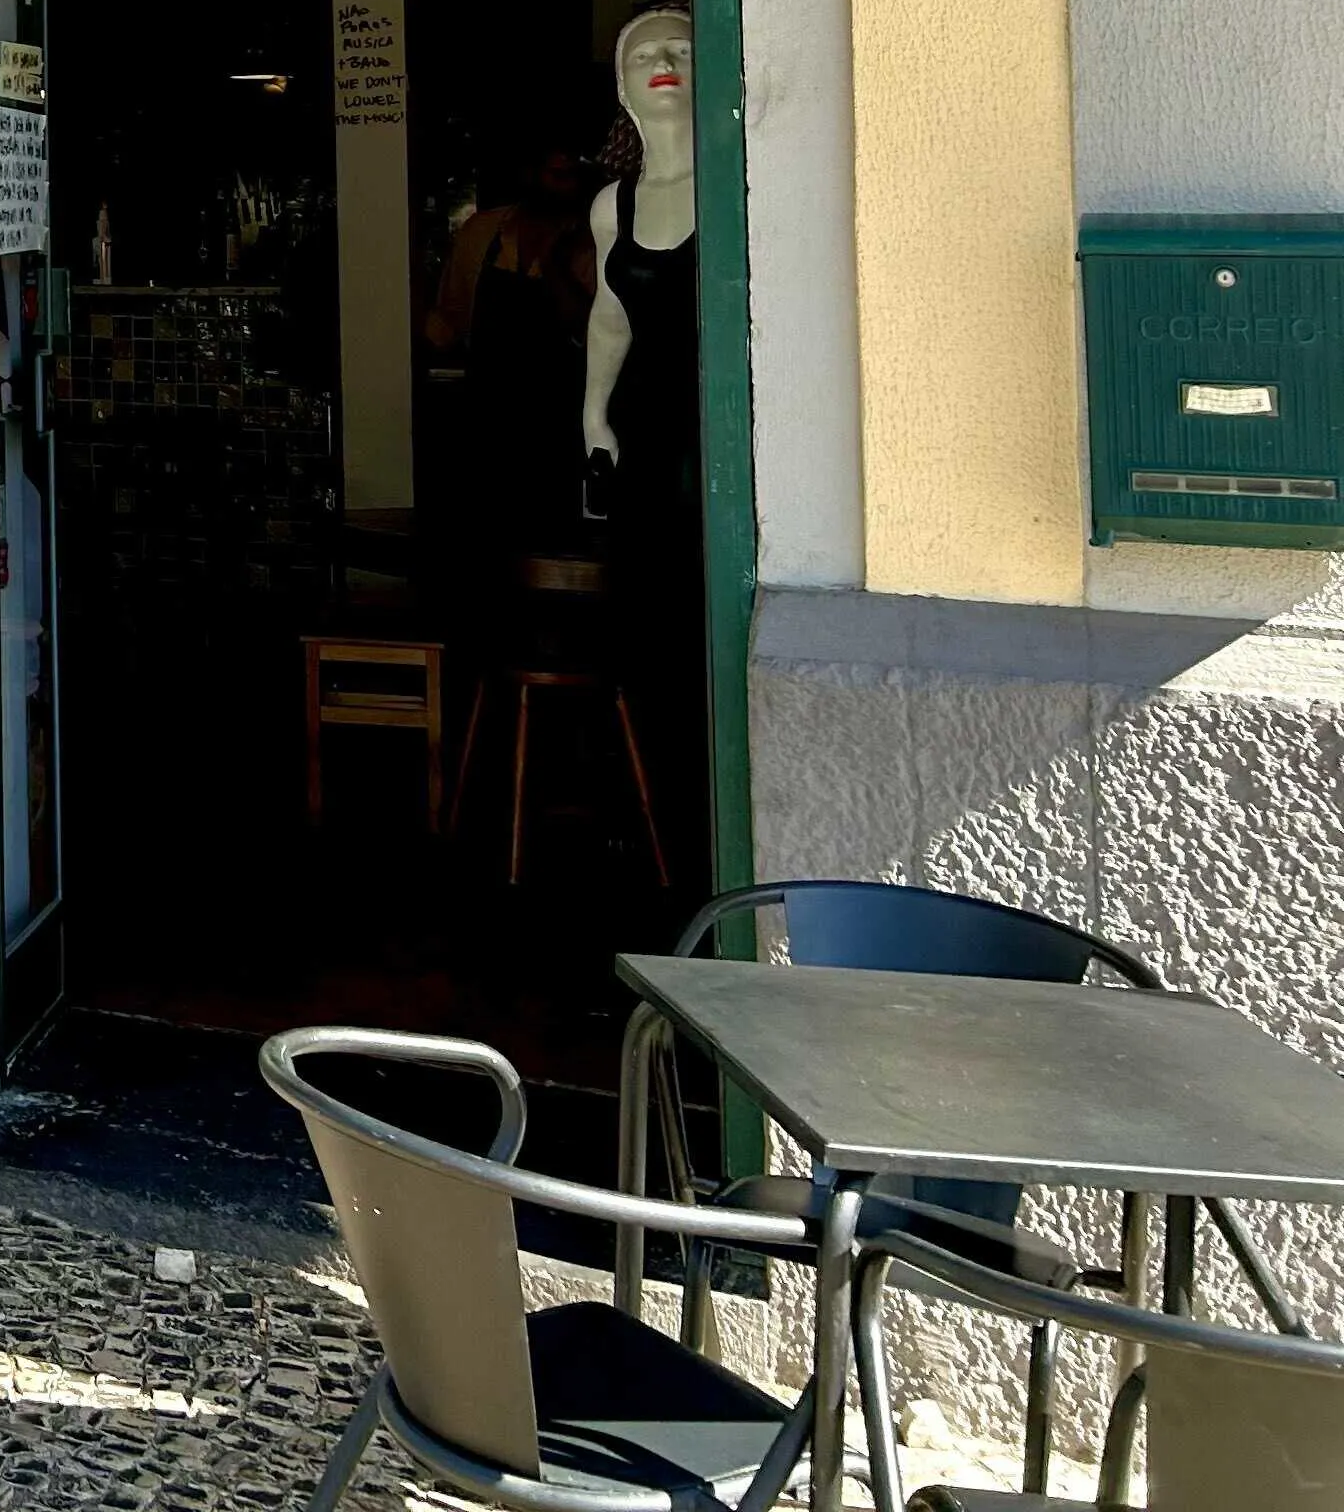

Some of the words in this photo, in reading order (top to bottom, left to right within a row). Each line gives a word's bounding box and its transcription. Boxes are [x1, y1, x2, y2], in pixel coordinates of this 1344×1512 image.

[337, 78, 359, 90] WE
[343, 94, 400, 109] LOWER
[335, 114, 361, 126] THE
[1140, 316, 1316, 345] CORREIO
